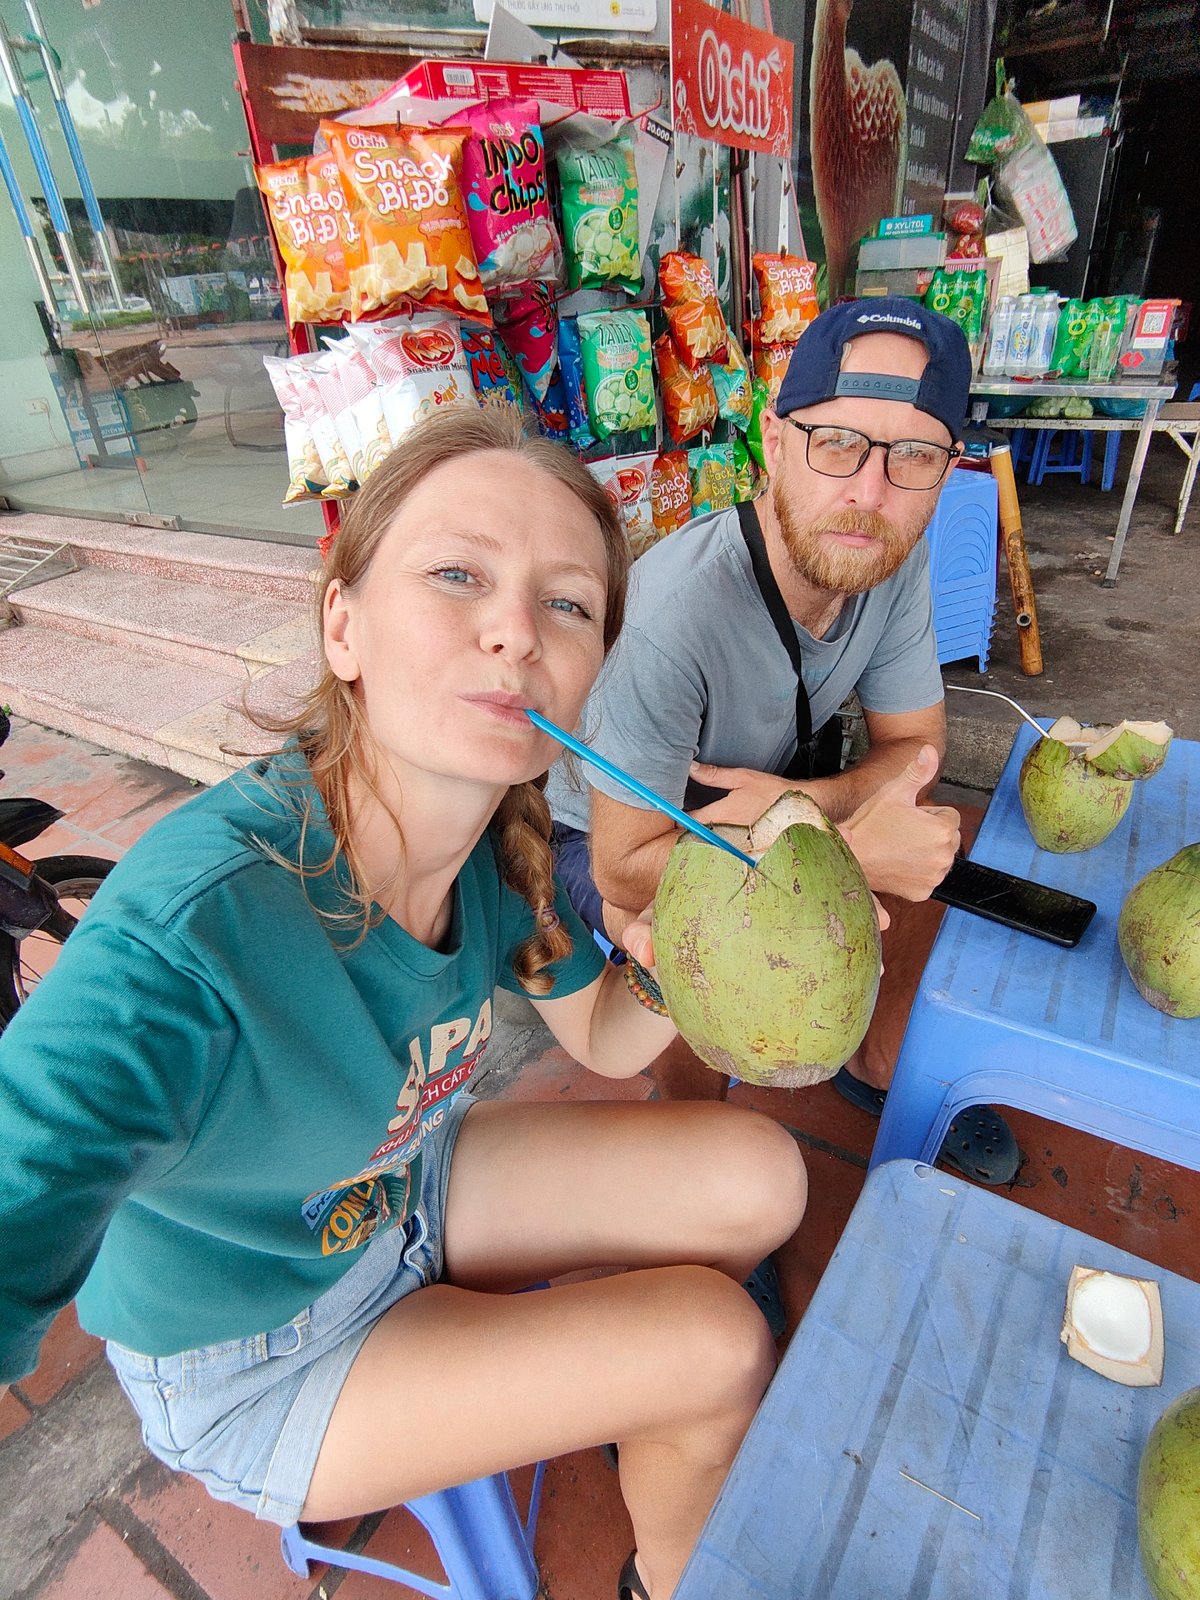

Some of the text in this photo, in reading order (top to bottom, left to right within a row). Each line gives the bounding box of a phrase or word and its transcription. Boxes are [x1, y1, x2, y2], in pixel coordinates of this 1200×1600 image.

[699, 29, 773, 139] Oishi
[347, 132, 388, 149] Oishi
[647, 121, 670, 141] 20.000
[354, 151, 454, 183] Snack
[480, 131, 541, 180] INDO
[377, 178, 449, 214] Bí Đỏ
[490, 170, 546, 217] Chips
[894, 220, 924, 230] XYLITOL
[768, 265, 814, 281] Snack
[869, 314, 921, 330] Columbia
[406, 366, 432, 374] Snack
[651, 472, 691, 499] Snack
